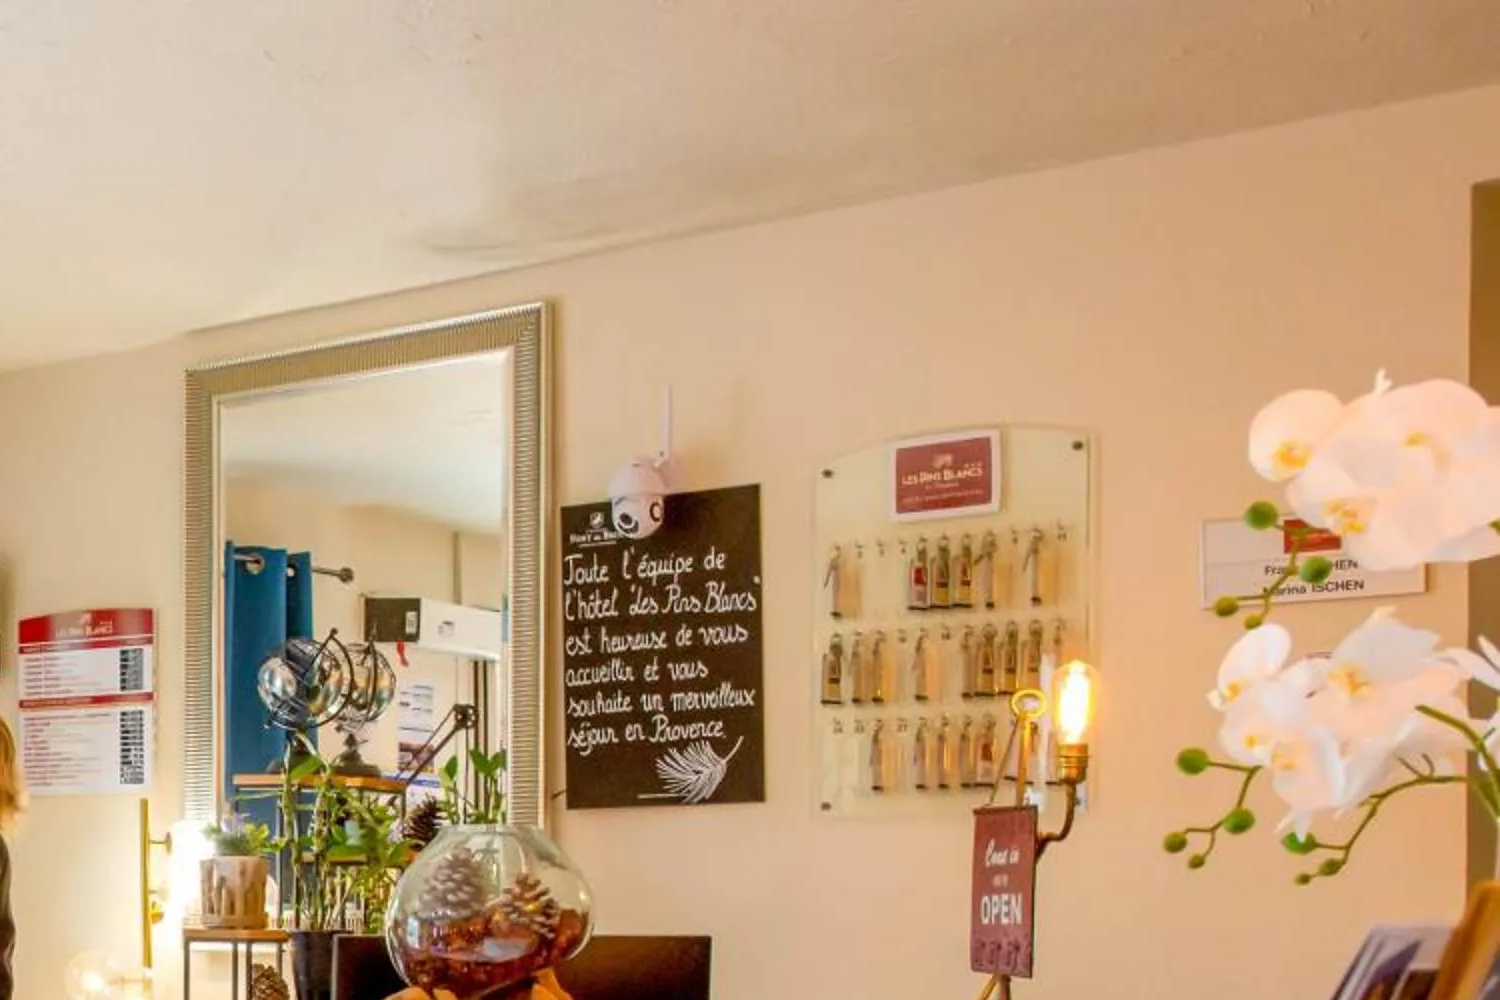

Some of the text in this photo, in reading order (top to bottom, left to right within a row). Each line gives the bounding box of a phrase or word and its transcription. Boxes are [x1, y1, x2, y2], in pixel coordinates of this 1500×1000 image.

[564, 546, 726, 586] Toute l'équipe de
[662, 583, 701, 615] Pins
[1311, 578, 1365, 594] ISCHEN
[565, 624, 750, 656] est heureuse de vous
[565, 656, 709, 688] accueillir et vous
[567, 681, 757, 718] souhaite un merveilleux
[567, 721, 619, 757] séjour
[625, 722, 646, 742] en
[980, 892, 1023, 926] OPEN
